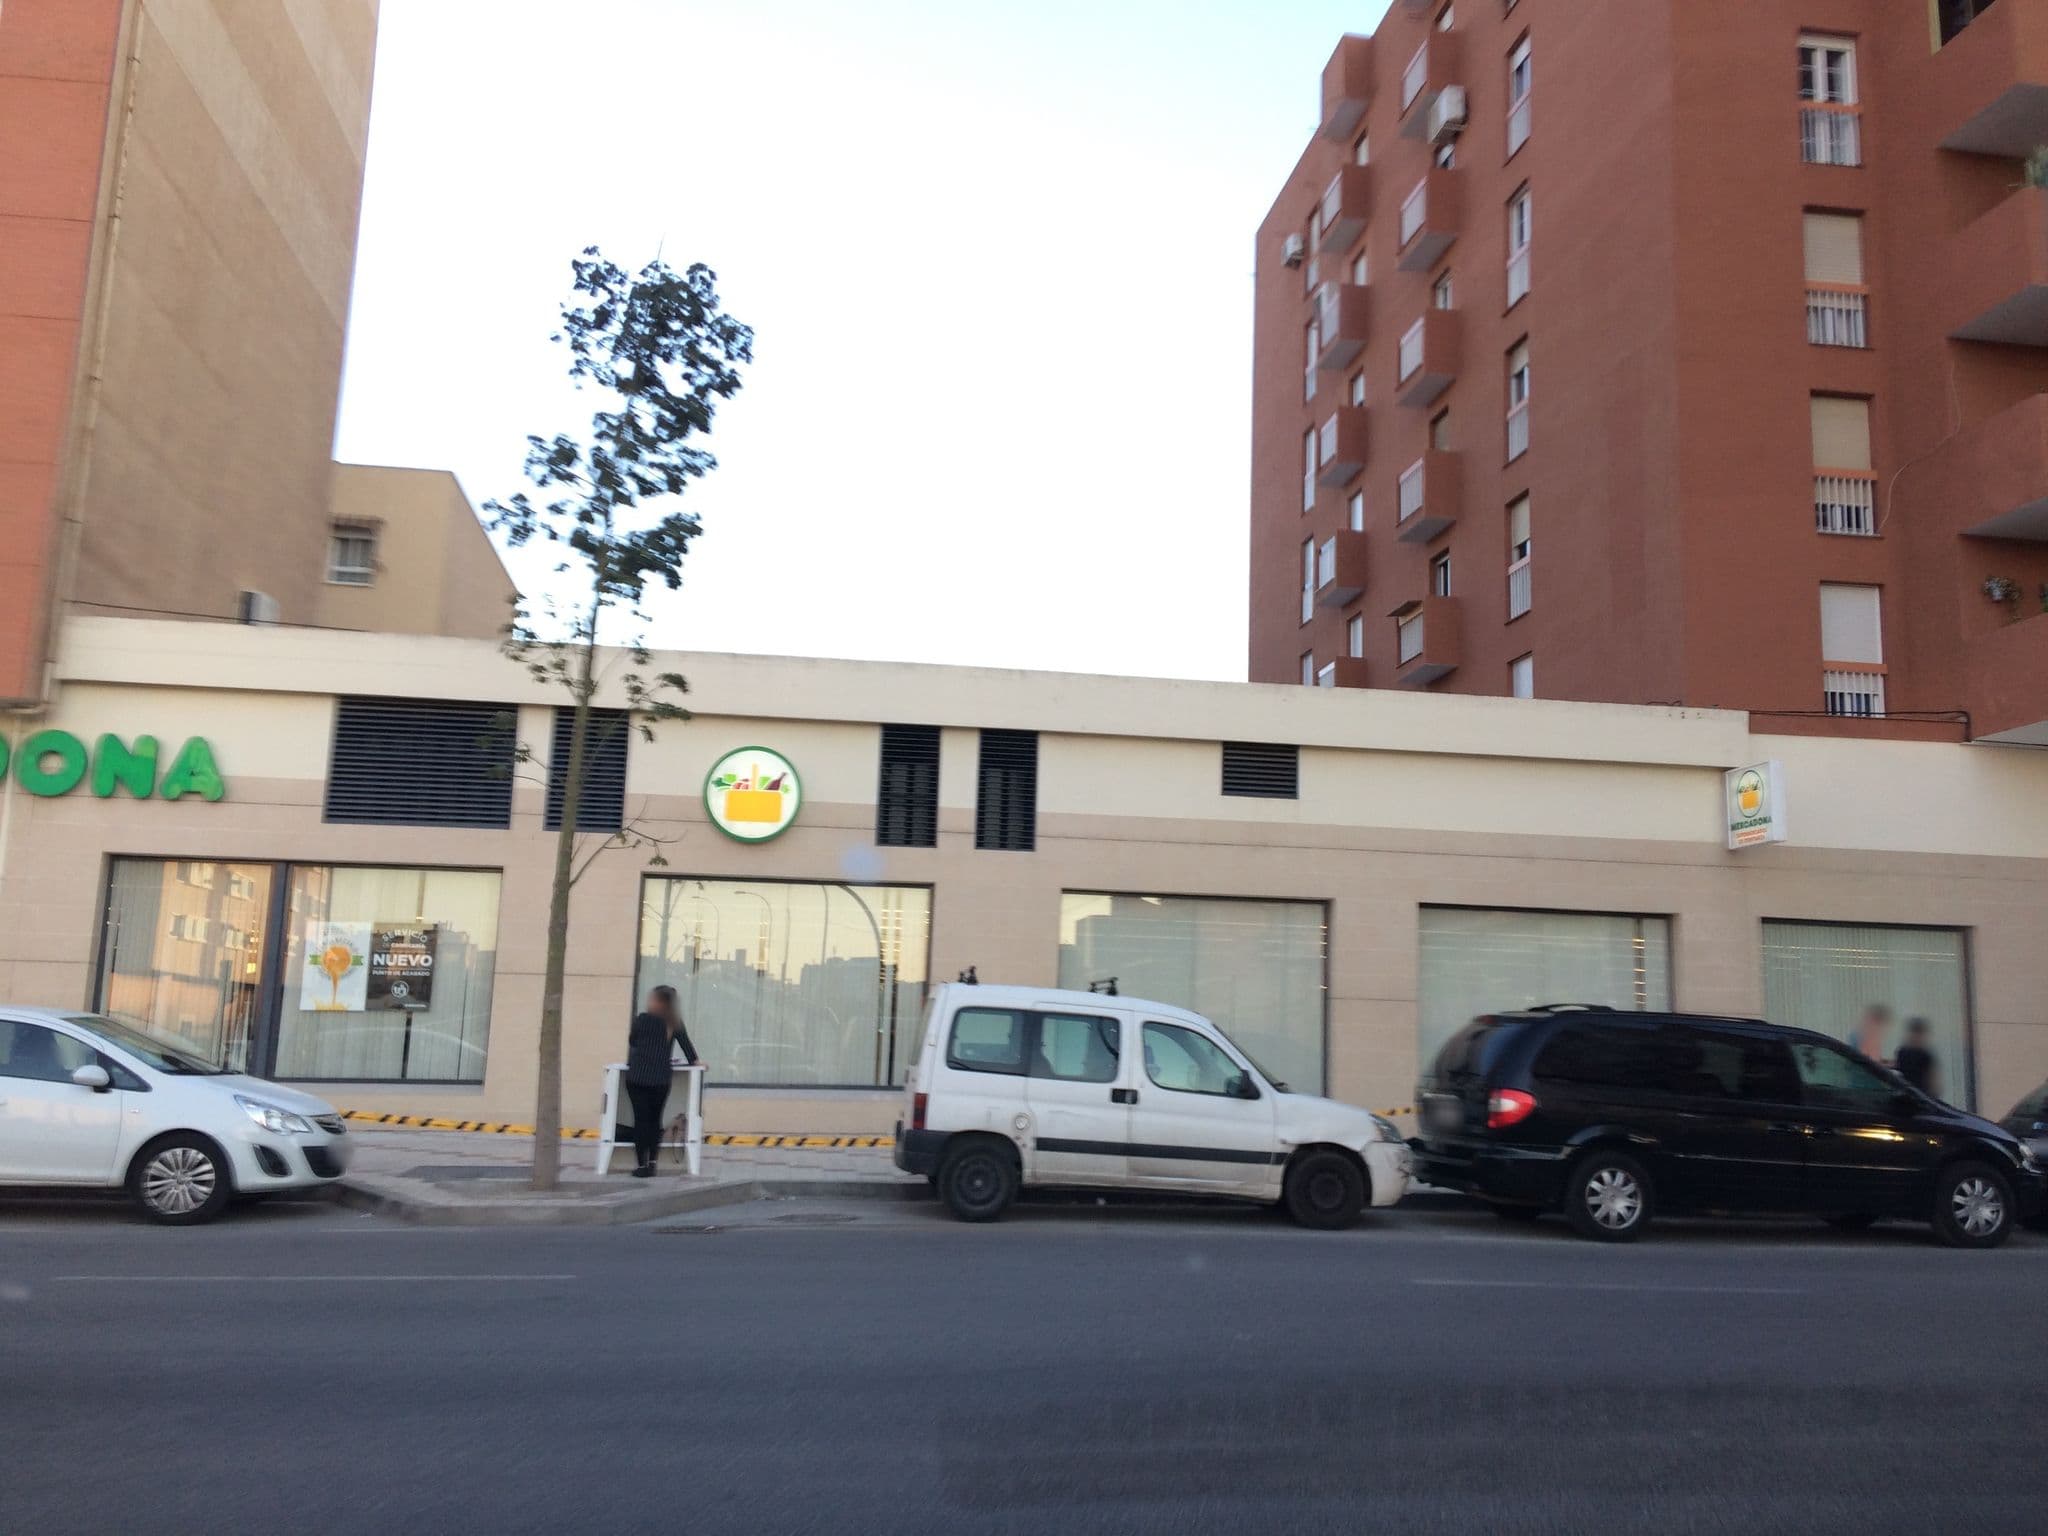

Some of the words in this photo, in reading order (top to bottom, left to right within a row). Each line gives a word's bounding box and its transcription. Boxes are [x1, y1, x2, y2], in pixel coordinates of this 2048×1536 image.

[0, 729, 223, 801] ONA
[382, 928, 428, 943] SERVICIO
[373, 953, 433, 967] NUEVO
